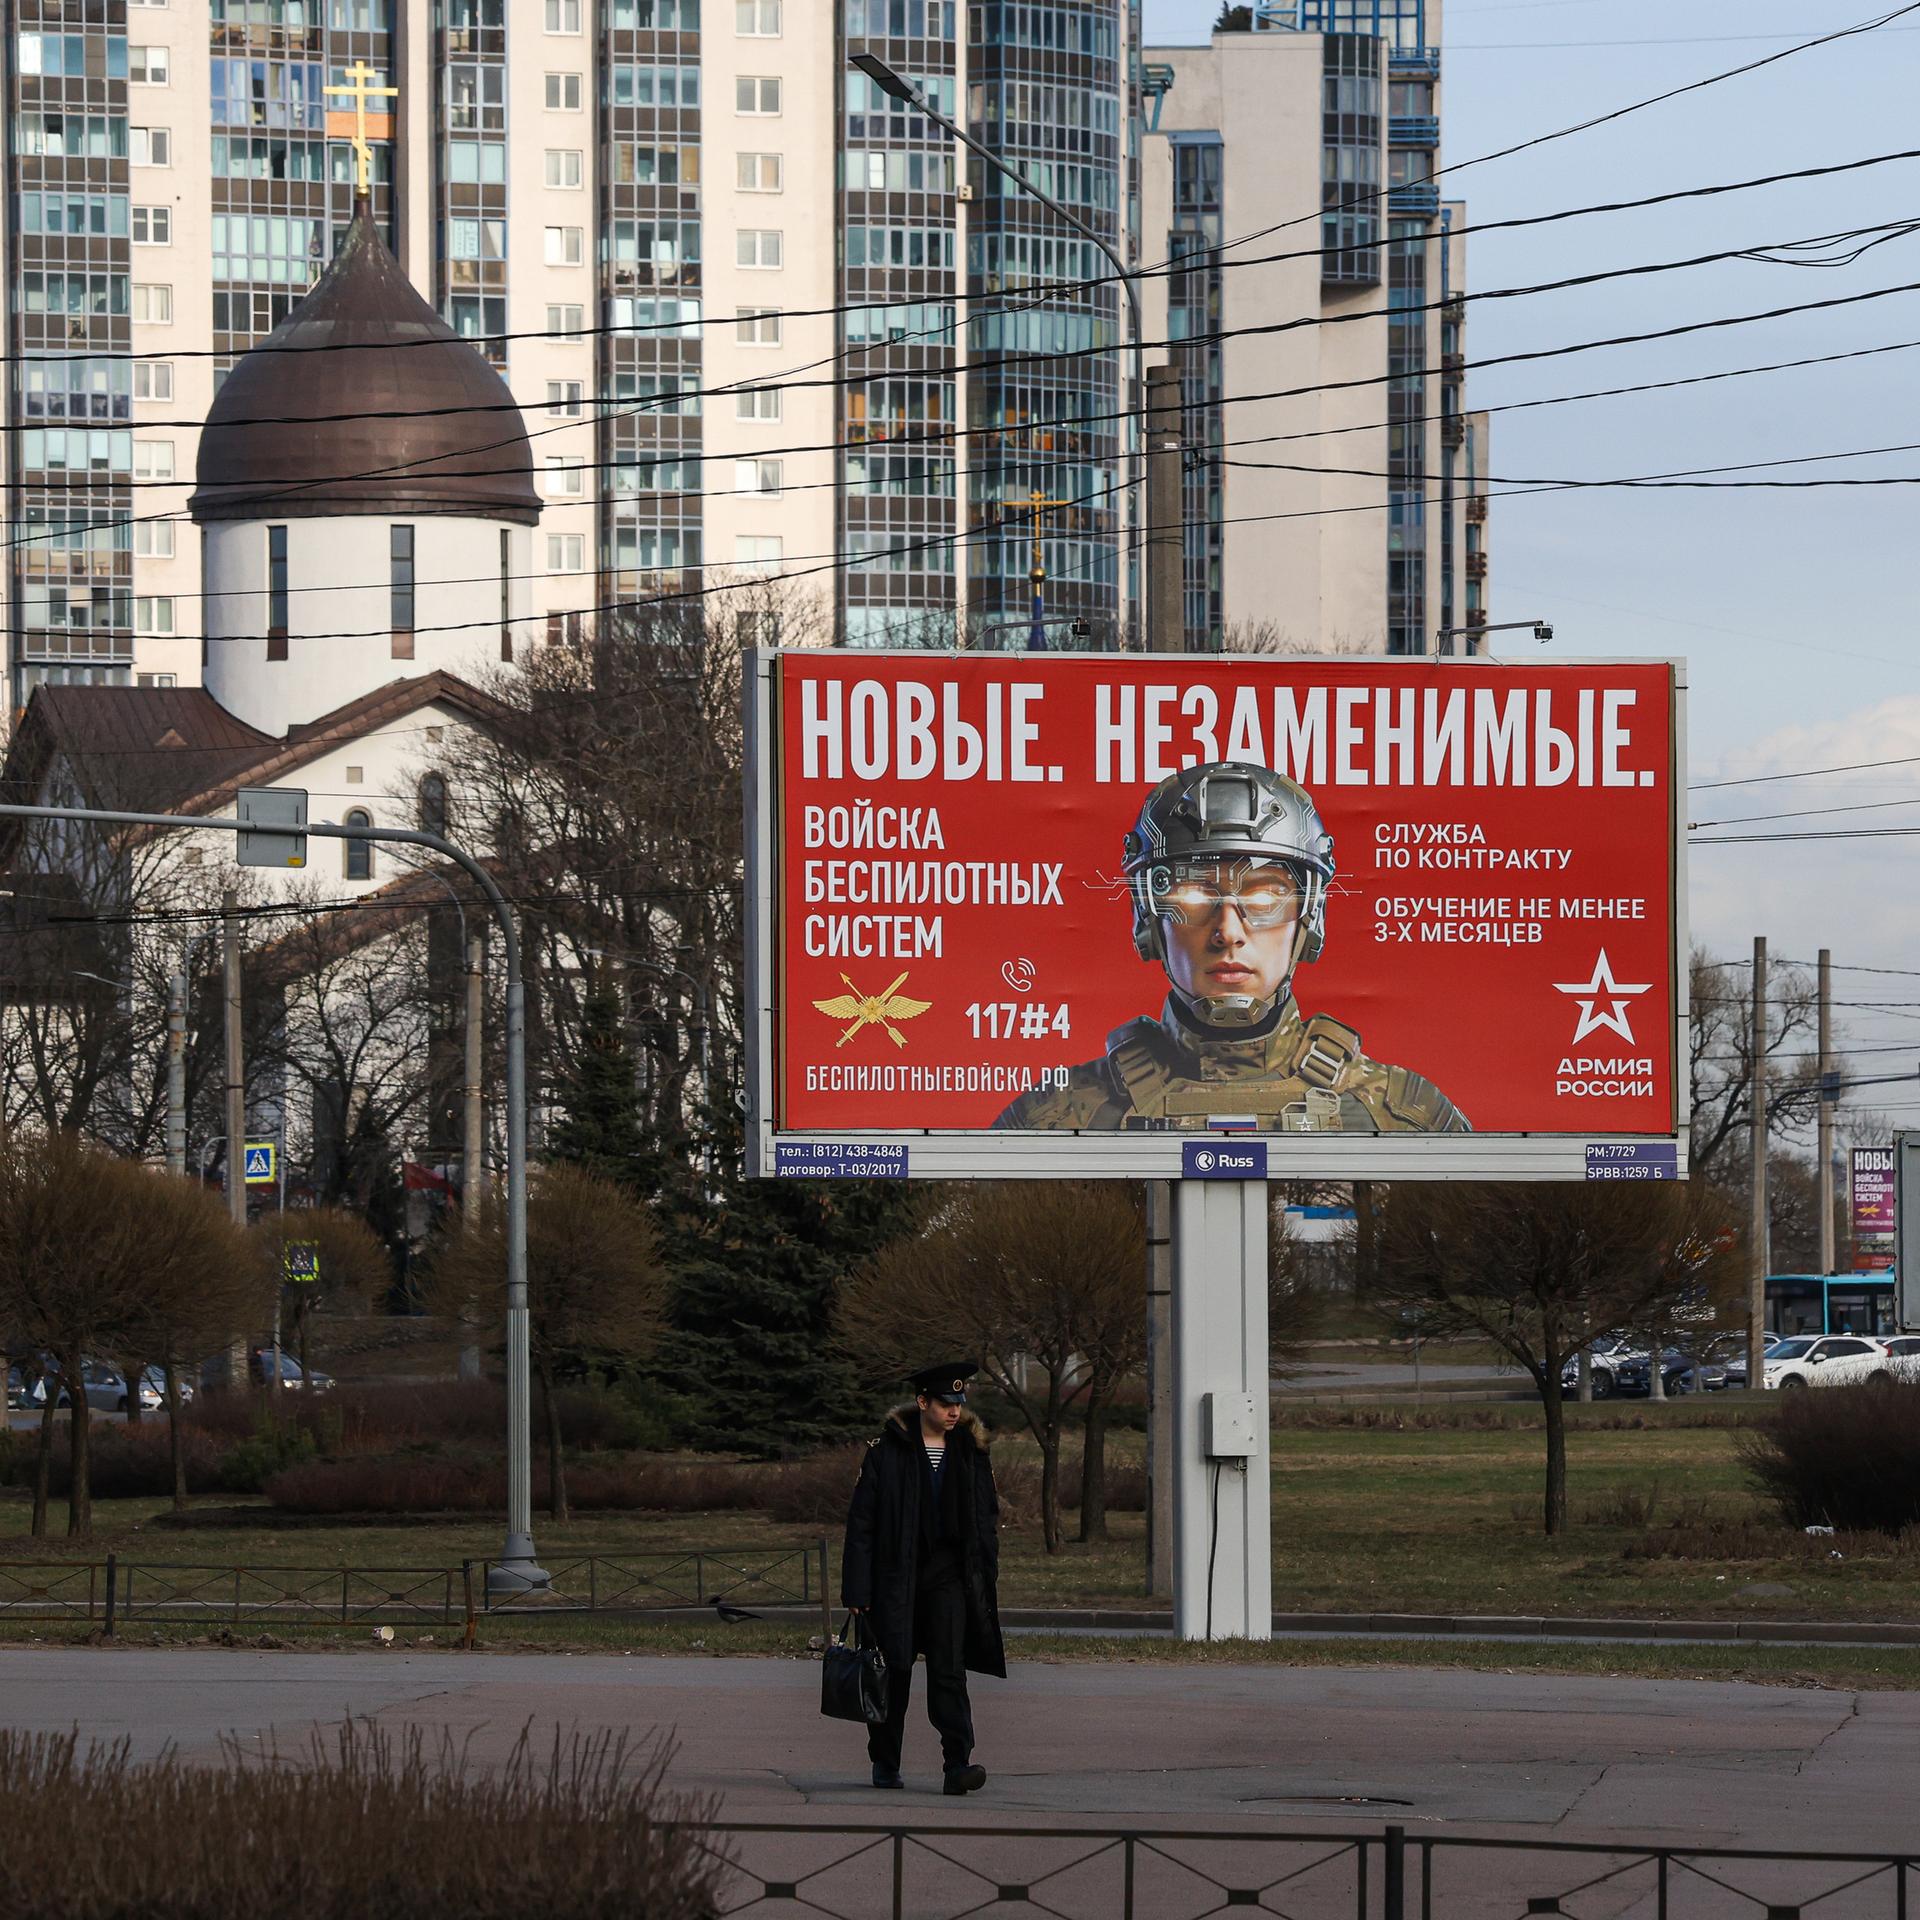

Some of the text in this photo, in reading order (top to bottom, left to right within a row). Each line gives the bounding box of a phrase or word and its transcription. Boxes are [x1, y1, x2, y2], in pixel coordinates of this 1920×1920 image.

[801, 679, 1655, 788] НОВЫЕ. НЕЗАМЕНИМЫЕ.
[804, 798, 945, 850] ВОЙСКА
[1375, 823, 1486, 844] СЛУЖБА
[1375, 847, 1572, 869] ПО КОНТРАКТУ
[804, 860, 1064, 905] БЕСПИЛОТНЫХ
[1375, 897, 1645, 919] ОБУЧЕНИЕ НЕ МЕНЕЕ
[805, 914, 942, 958] СИСТЕМ
[1374, 922, 1542, 947] 3-Х МЕСЯЦЕВ
[965, 1003, 1071, 1039] 117#4
[806, 1062, 1070, 1092] БЕСПИЛОТНЫЕВОЙСКА.РФ
[1556, 1058, 1653, 1076] АРМИЯ
[1556, 1080, 1653, 1097] РОССИИ
[780, 1145, 903, 1159] тел.: (812) 438-4848
[1219, 1155, 1254, 1168] Russ
[779, 1163, 900, 1178] договор: Т-03/2017
[1588, 1167, 1663, 1179] SPBB:1259 Б
